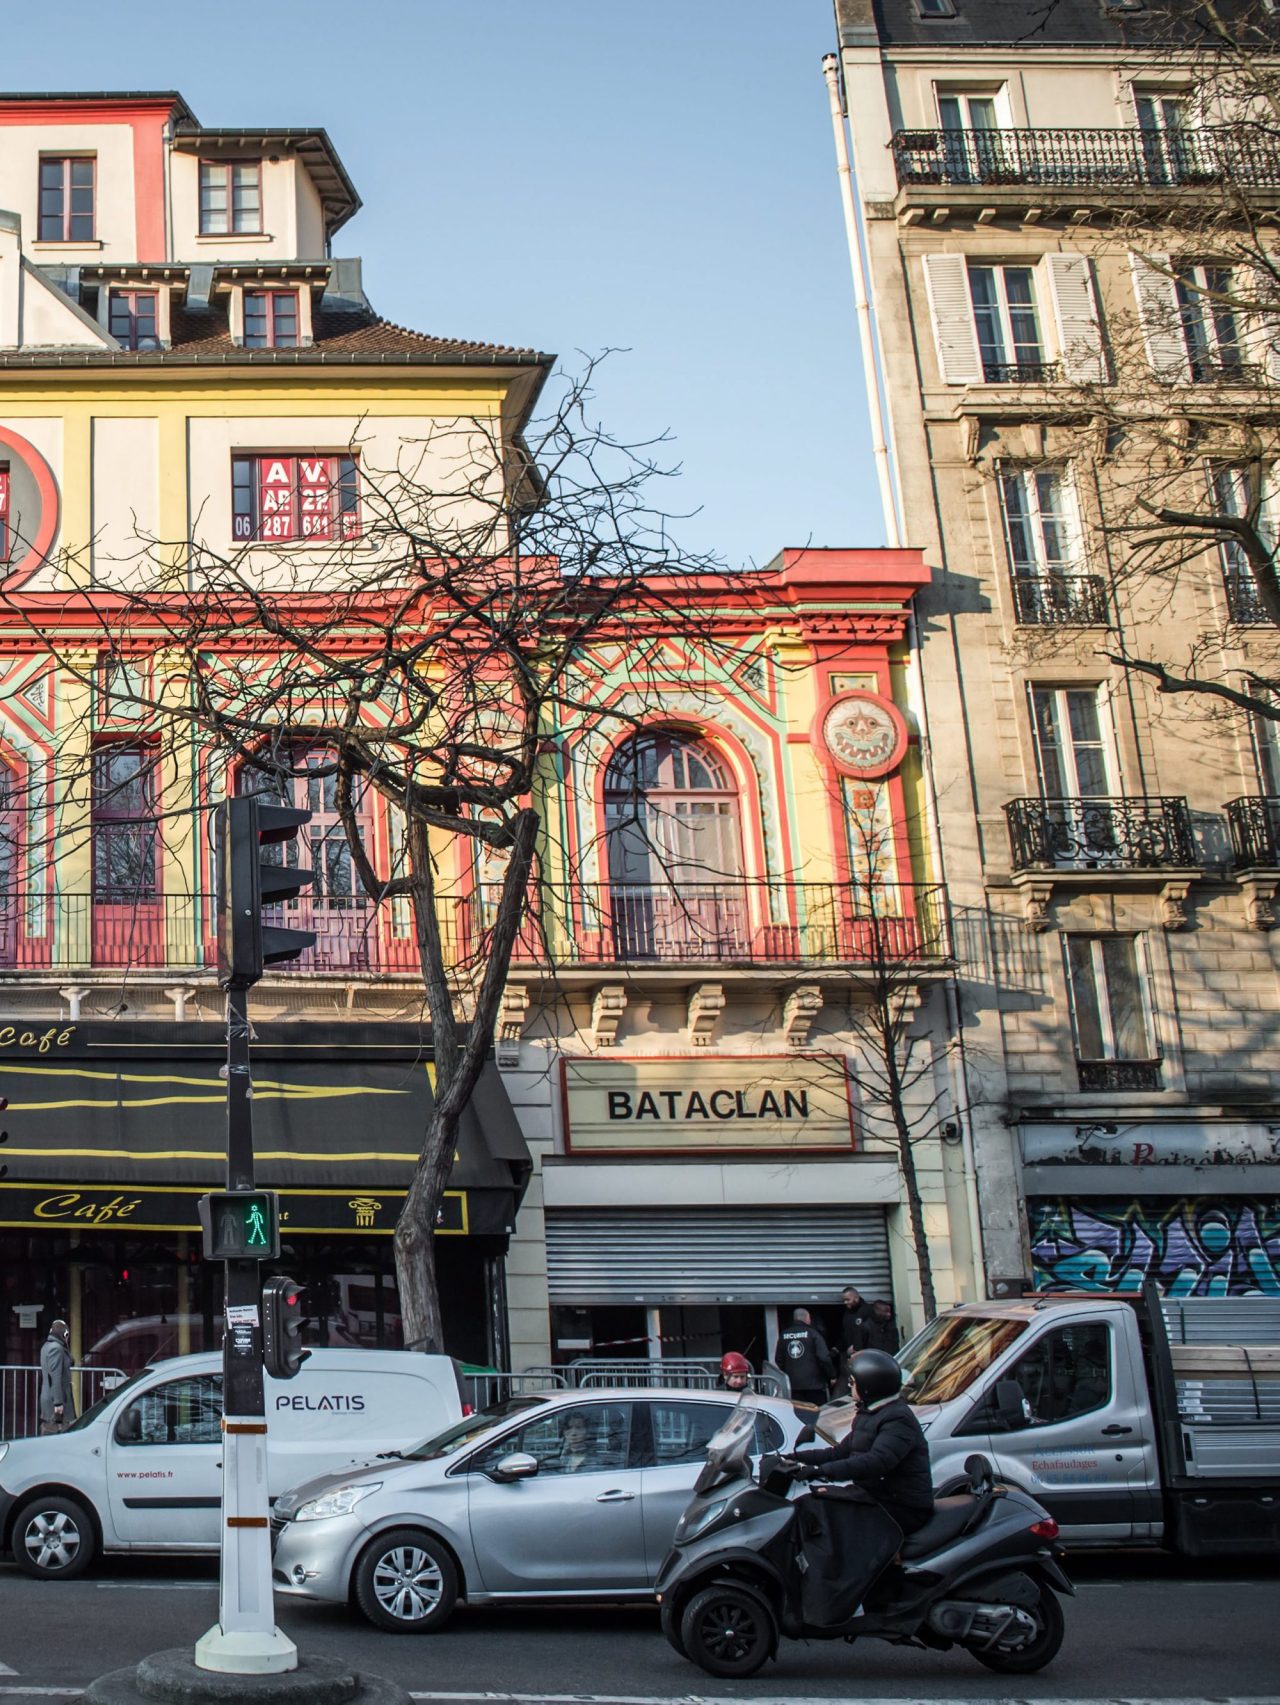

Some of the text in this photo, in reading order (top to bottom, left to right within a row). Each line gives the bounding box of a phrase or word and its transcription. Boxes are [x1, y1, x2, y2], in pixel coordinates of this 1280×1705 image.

[235, 516, 251, 536] 06
[263, 516, 290, 536] 287
[608, 1090, 810, 1119] BATACLAN
[33, 1194, 141, 1223] Café
[276, 1396, 365, 1410] PELATIS
[1032, 1460, 1098, 1471] Echafaudages
[117, 1470, 173, 1479] www.pelatis.fr
